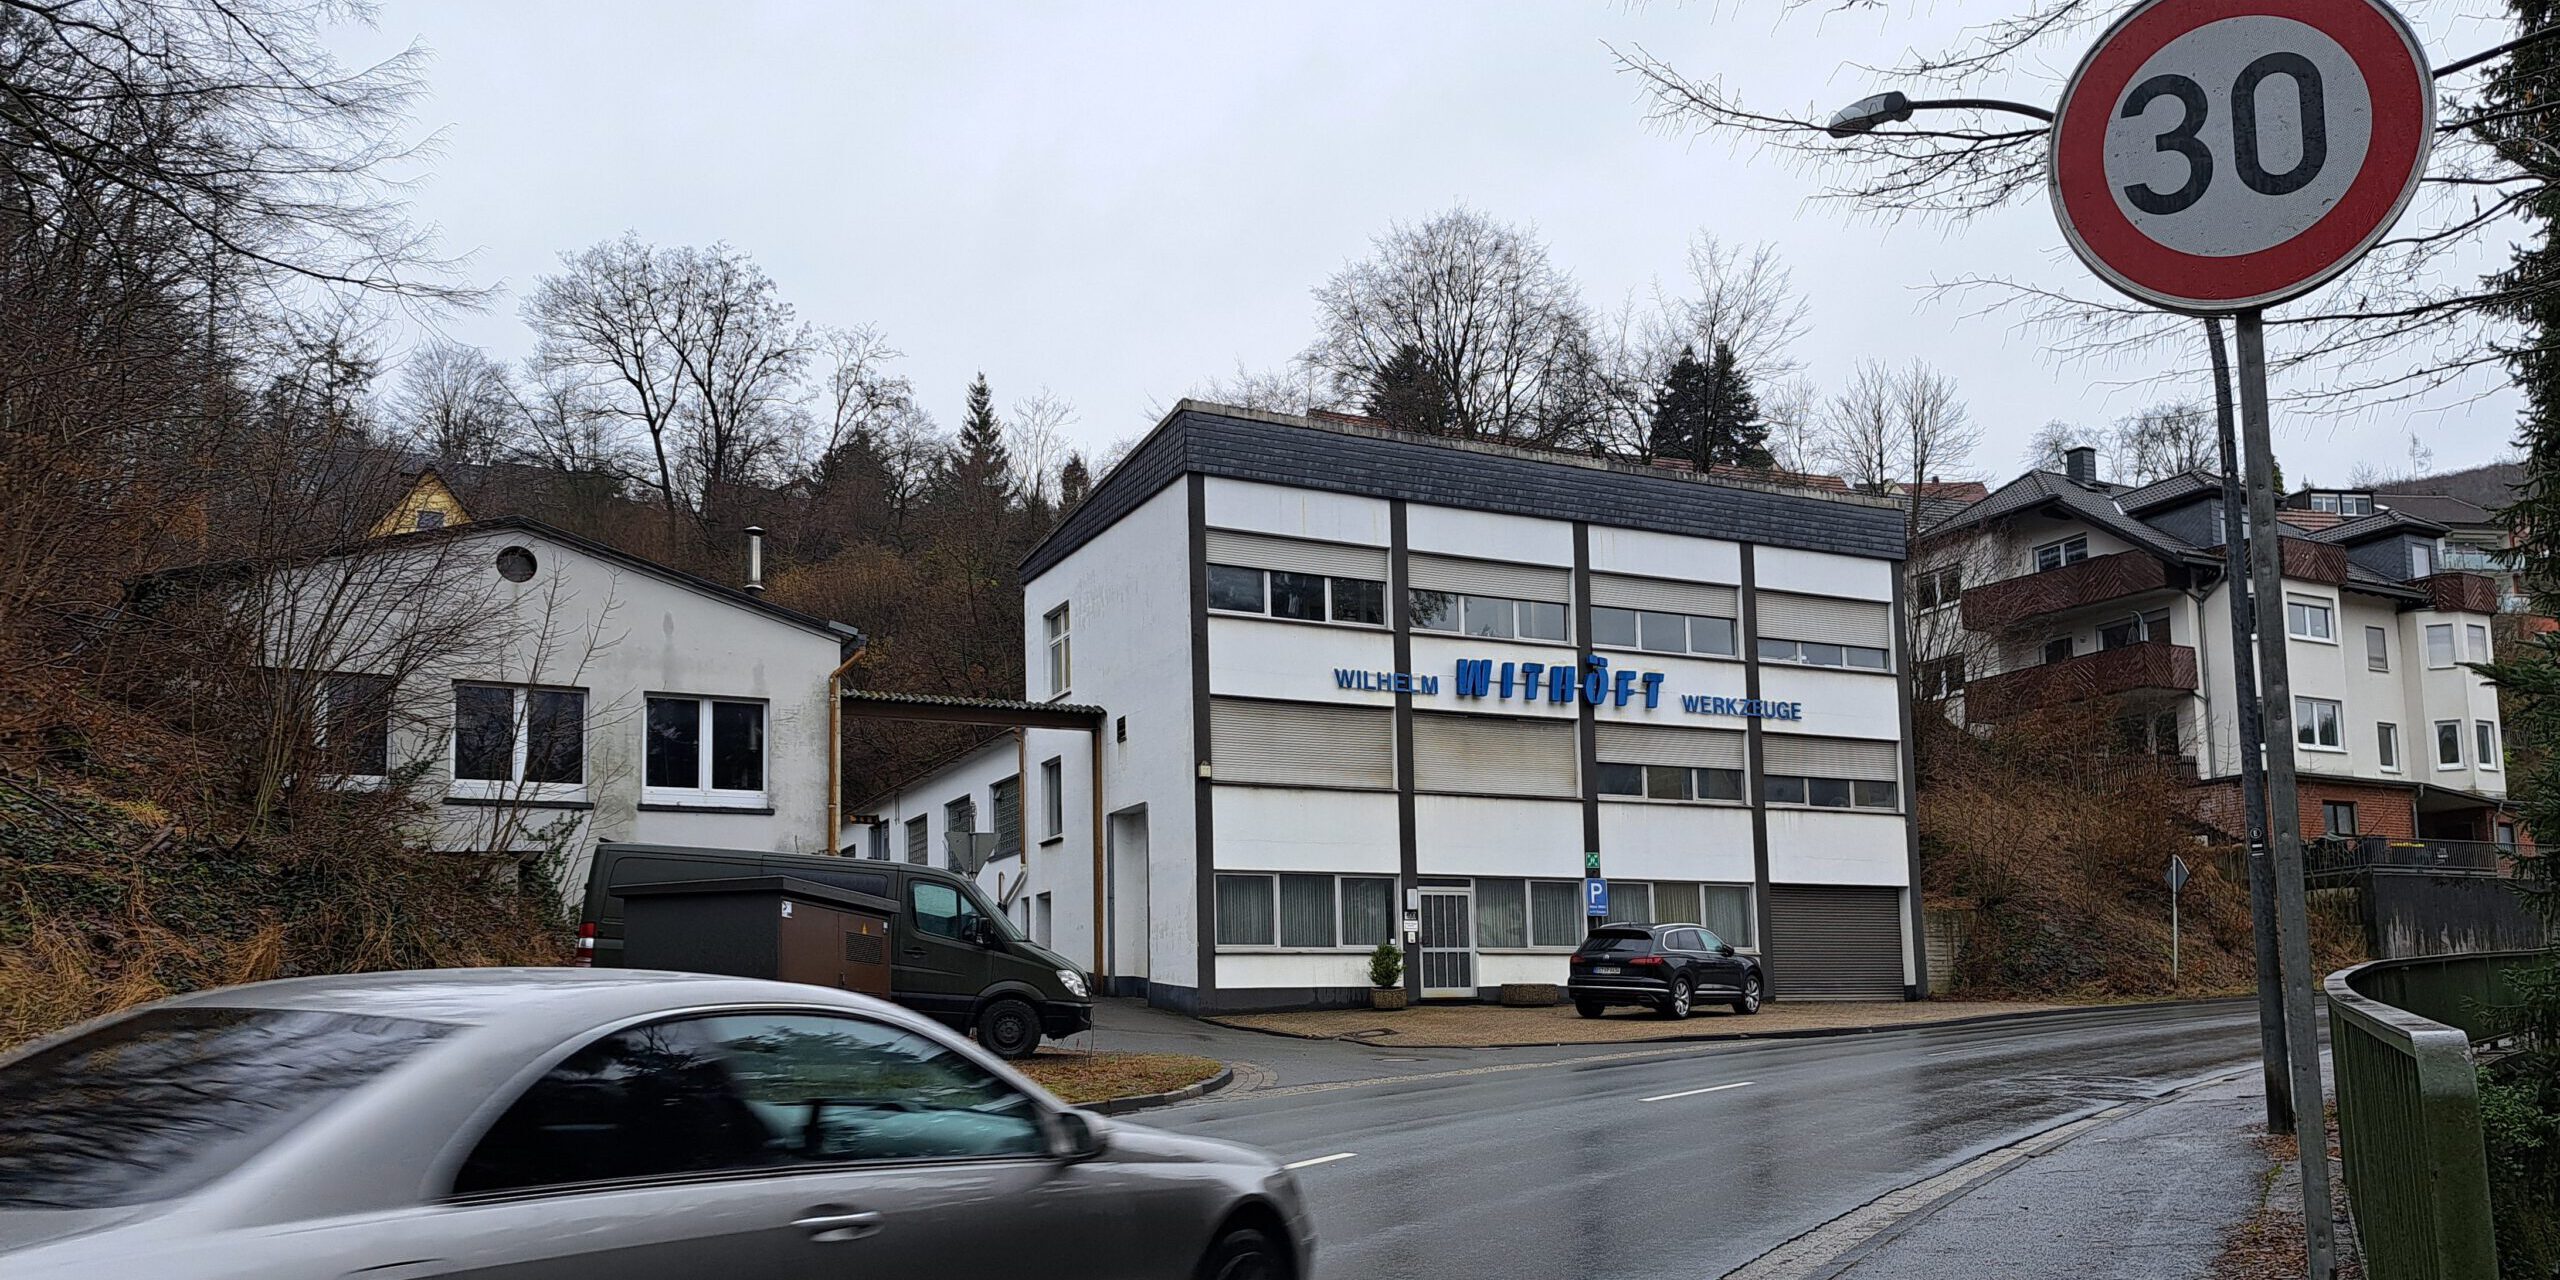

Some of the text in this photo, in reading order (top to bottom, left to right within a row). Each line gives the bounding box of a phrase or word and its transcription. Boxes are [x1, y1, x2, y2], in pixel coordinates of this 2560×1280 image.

[2120, 52, 2327, 215] 30
[1334, 654, 1802, 720] WILHELM WITHÖFT WERKZEUGE
[1590, 882, 1603, 904] P
